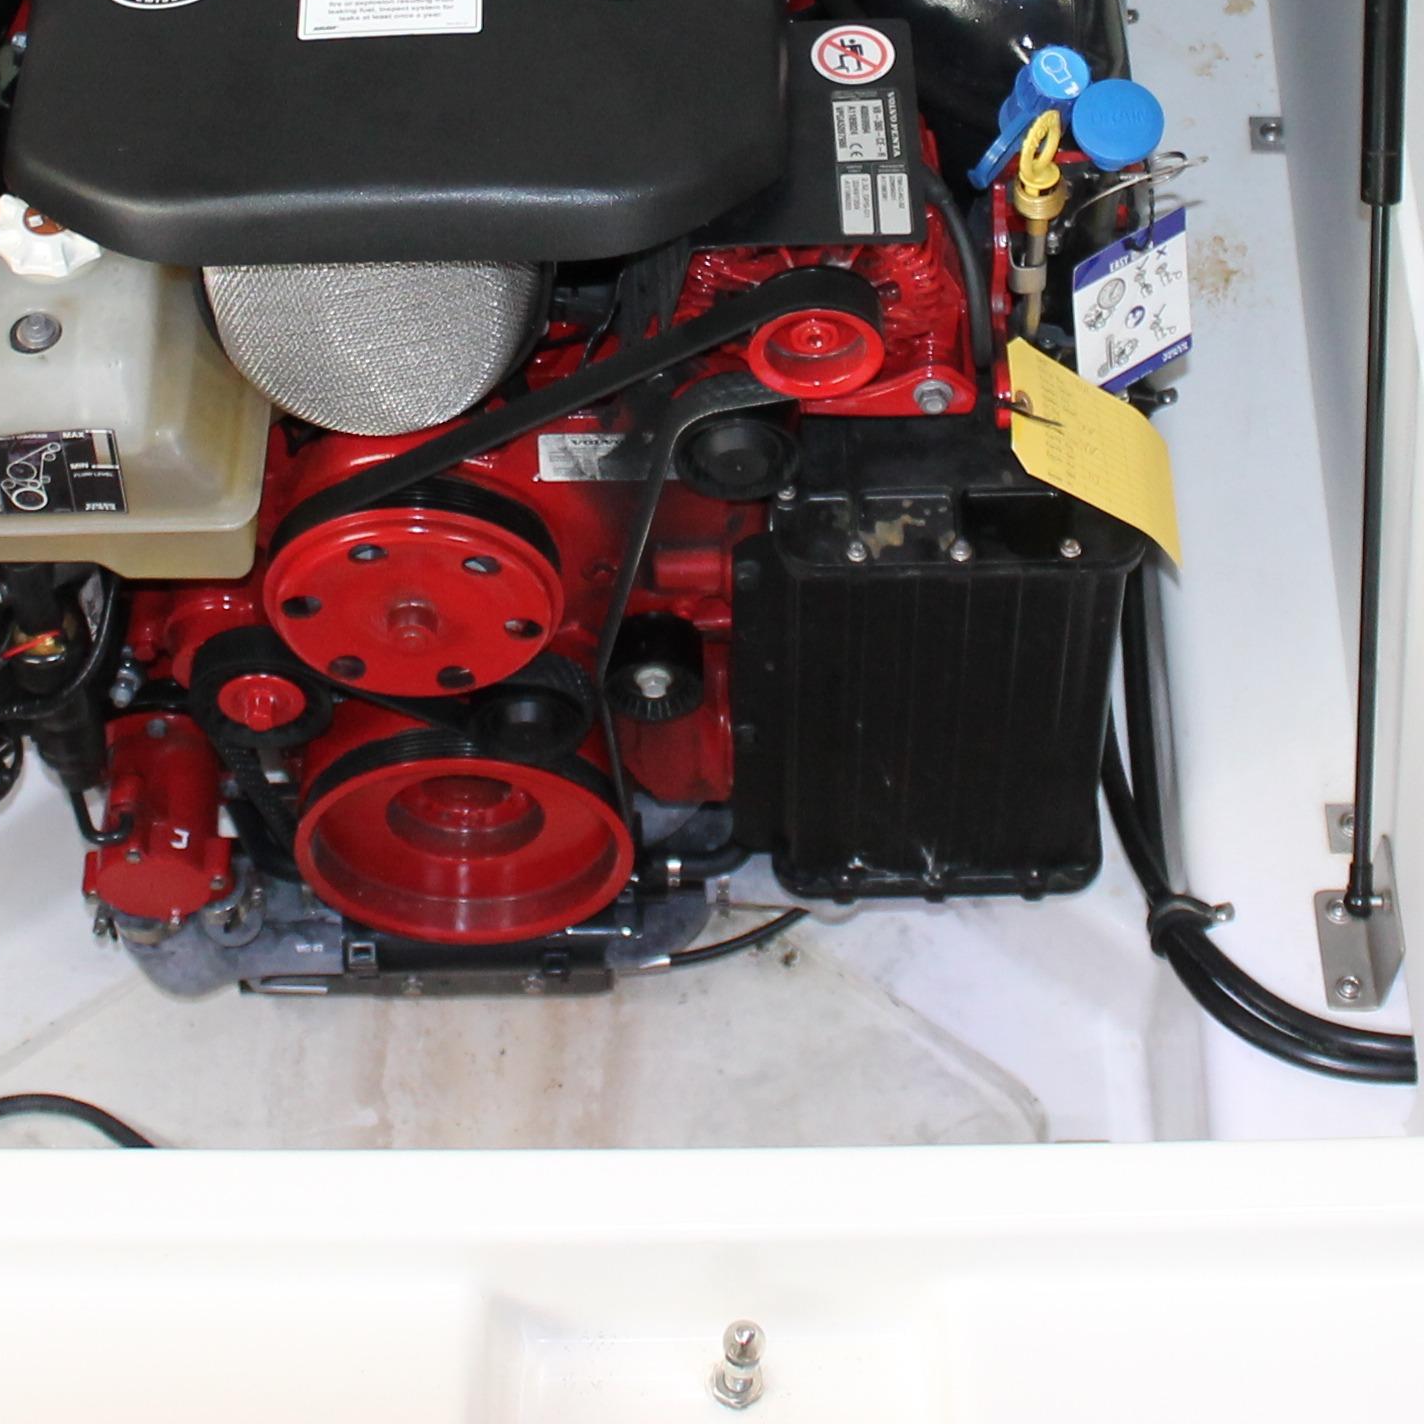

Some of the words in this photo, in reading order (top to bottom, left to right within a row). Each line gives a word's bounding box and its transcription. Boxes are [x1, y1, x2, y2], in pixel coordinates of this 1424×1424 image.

[887, 91, 898, 123] VOLVO
[890, 123, 902, 158] PENTA
[1108, 252, 1133, 274] EASY
[62, 431, 85, 439] MAX
